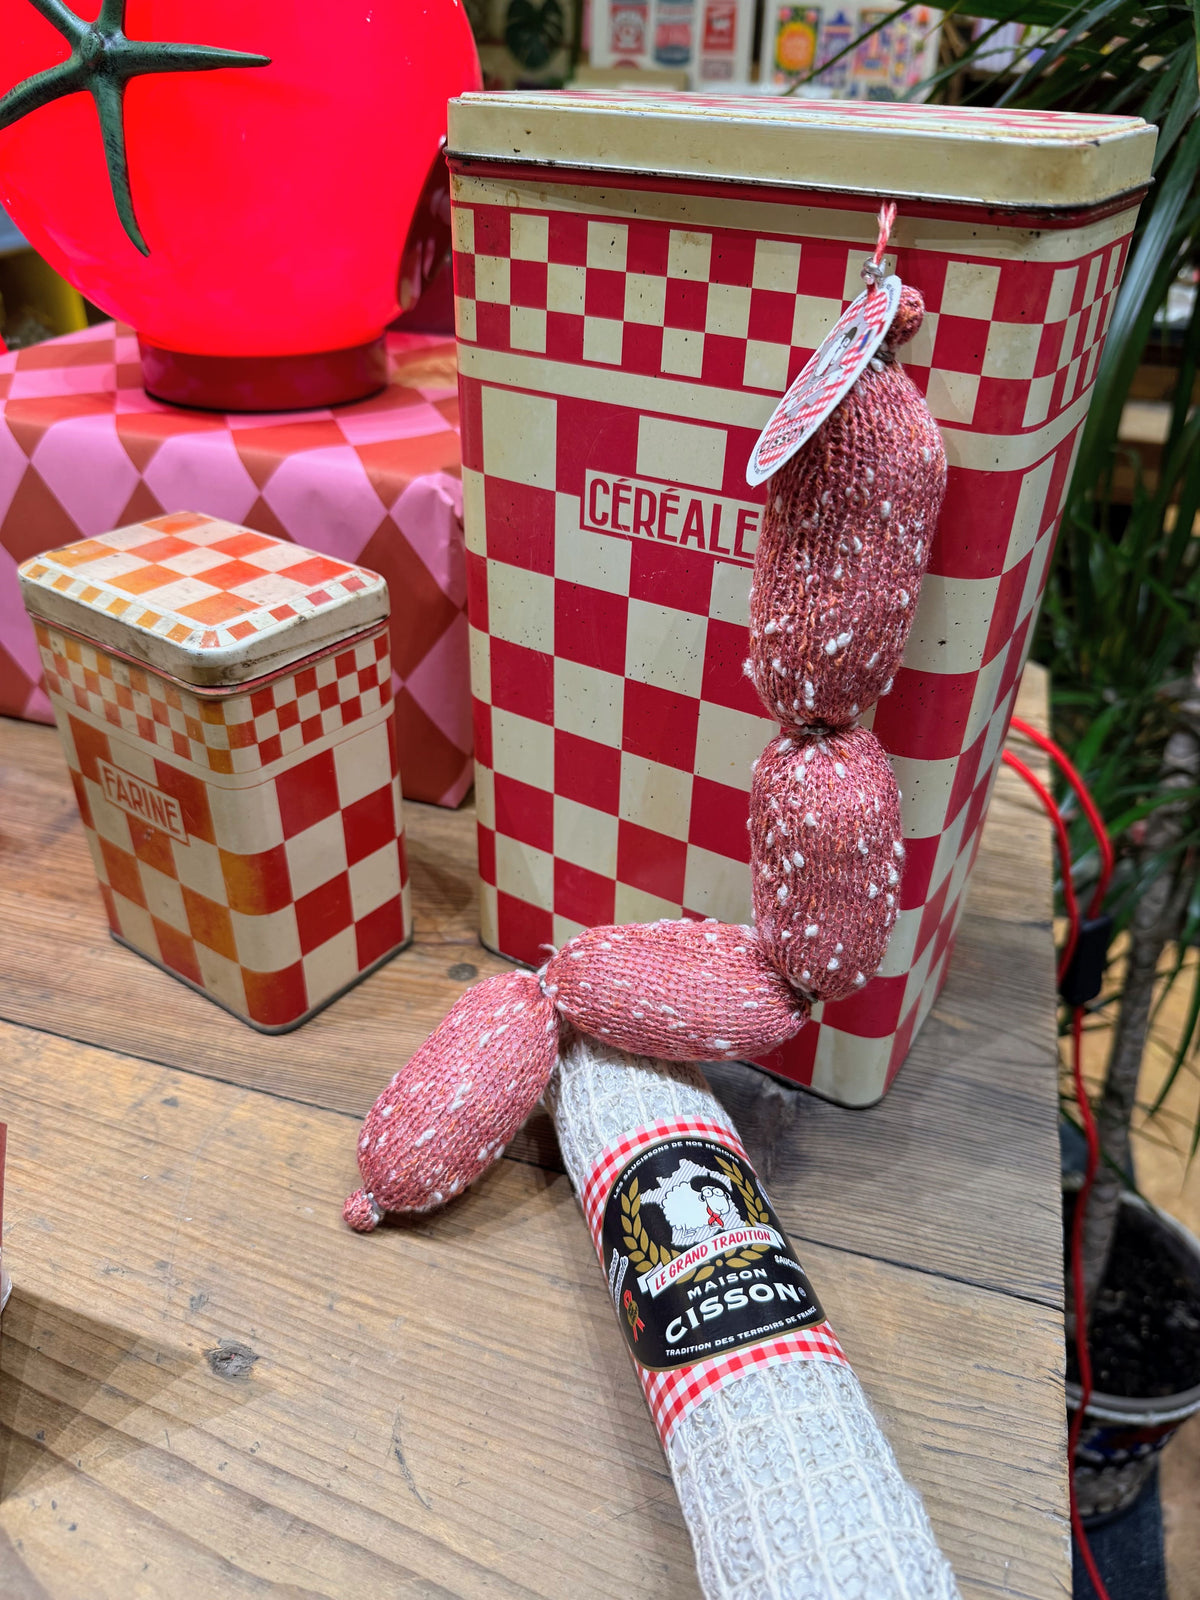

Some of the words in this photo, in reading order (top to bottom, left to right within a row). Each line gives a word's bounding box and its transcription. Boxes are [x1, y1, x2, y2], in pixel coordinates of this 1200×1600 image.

[589, 478, 761, 560] CÉRÉALE
[102, 765, 182, 835] FARINE
[613, 1181, 624, 1200] LES
[623, 1144, 669, 1180] SAUCISSONS
[671, 1141, 683, 1149] DE
[705, 1142, 740, 1164] RÉGIONS
[655, 1268, 666, 1291] LE
[668, 1244, 709, 1278] GRAND
[711, 1229, 772, 1251] TRADITION
[686, 1268, 768, 1300] MAISON
[665, 1341, 712, 1357] TRADITION
[714, 1335, 735, 1346] DES
[737, 1320, 784, 1340] TERROIRS
[785, 1315, 798, 1324] DE
[797, 1305, 817, 1319] FRANCE
